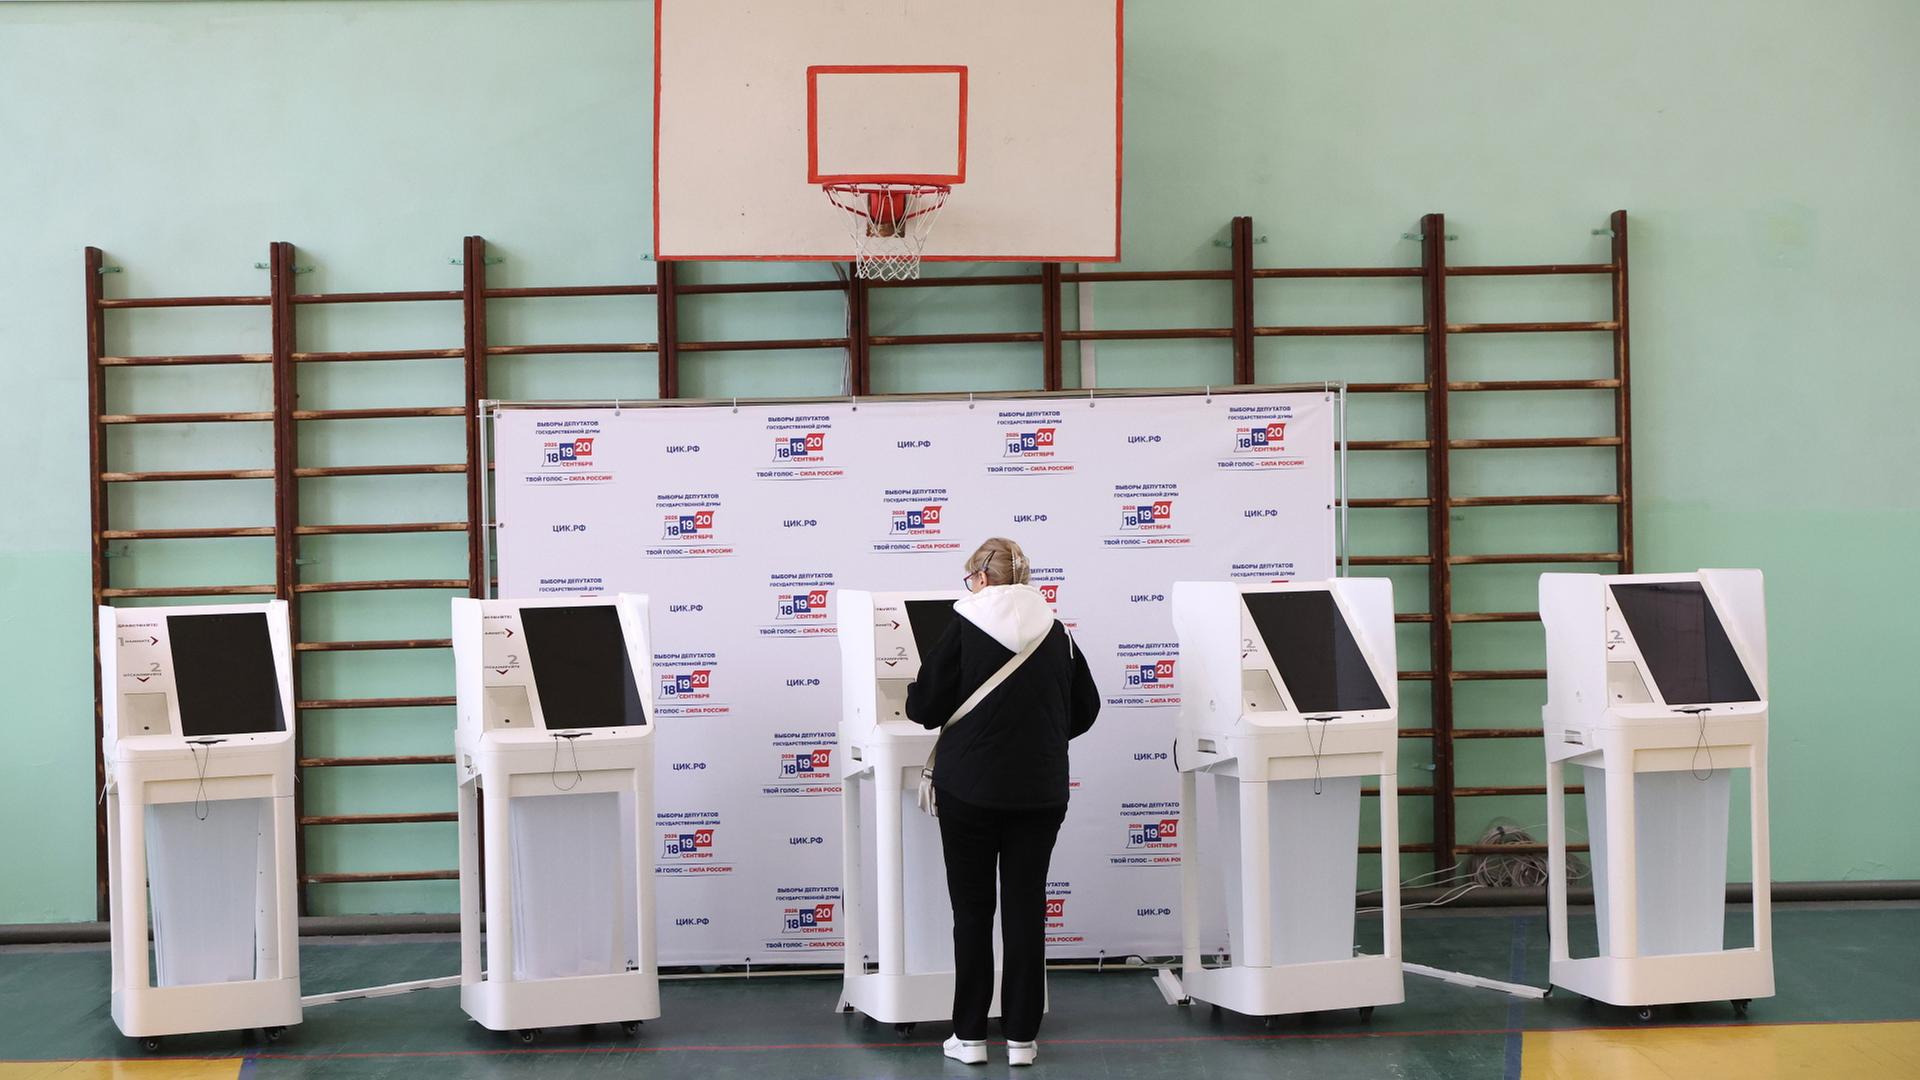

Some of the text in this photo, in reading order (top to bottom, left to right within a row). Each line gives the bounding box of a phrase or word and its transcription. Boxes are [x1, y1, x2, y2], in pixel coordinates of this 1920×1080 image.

[1127, 435, 1161, 444] ЦИК.РФ
[1238, 427, 1283, 448] 18 19 20
[897, 440, 931, 449] ЦИК.РФ
[1008, 432, 1053, 453] 18 19 20
[666, 445, 700, 454] ЦИК.РФ
[778, 437, 822, 458] 18 19 20
[546, 442, 591, 463] 18 19 20
[1124, 505, 1169, 526] 18 19 20
[1244, 509, 1278, 518] ЦИК.РФ
[894, 510, 939, 531] 18 19 20
[1013, 514, 1047, 523] ЦИК.РФ
[666, 515, 711, 536] 18 19 20
[783, 519, 817, 528] ЦИК.РФ
[552, 524, 586, 533] ЦИК.РФ
[1130, 594, 1164, 603] ЦИК.РФ
[669, 604, 703, 613] ЦИК.РФ
[780, 594, 825, 615] 18 19 20
[1611, 630, 1624, 639] 2
[1243, 639, 1255, 648] 2
[896, 647, 907, 656] 2
[507, 655, 519, 664] 2
[150, 662, 162, 672] 2
[1128, 664, 1172, 685] 18 19 20
[664, 674, 708, 695] 18 19 20
[786, 678, 820, 687] ЦИК.РФ
[1133, 752, 1167, 761] ЦИК.РФ
[672, 762, 706, 771] ЦИК.РФ
[784, 753, 828, 774] 18 19 20
[1132, 823, 1176, 844] 18 19 20
[666, 833, 711, 854] 18 19 20
[789, 837, 823, 846] ЦИК.РФ
[1047, 903, 1062, 913] 20
[1137, 908, 1171, 917] ЦИК.РФ
[675, 918, 709, 927] ЦИК.РФ
[786, 908, 831, 929] 18 19 20
